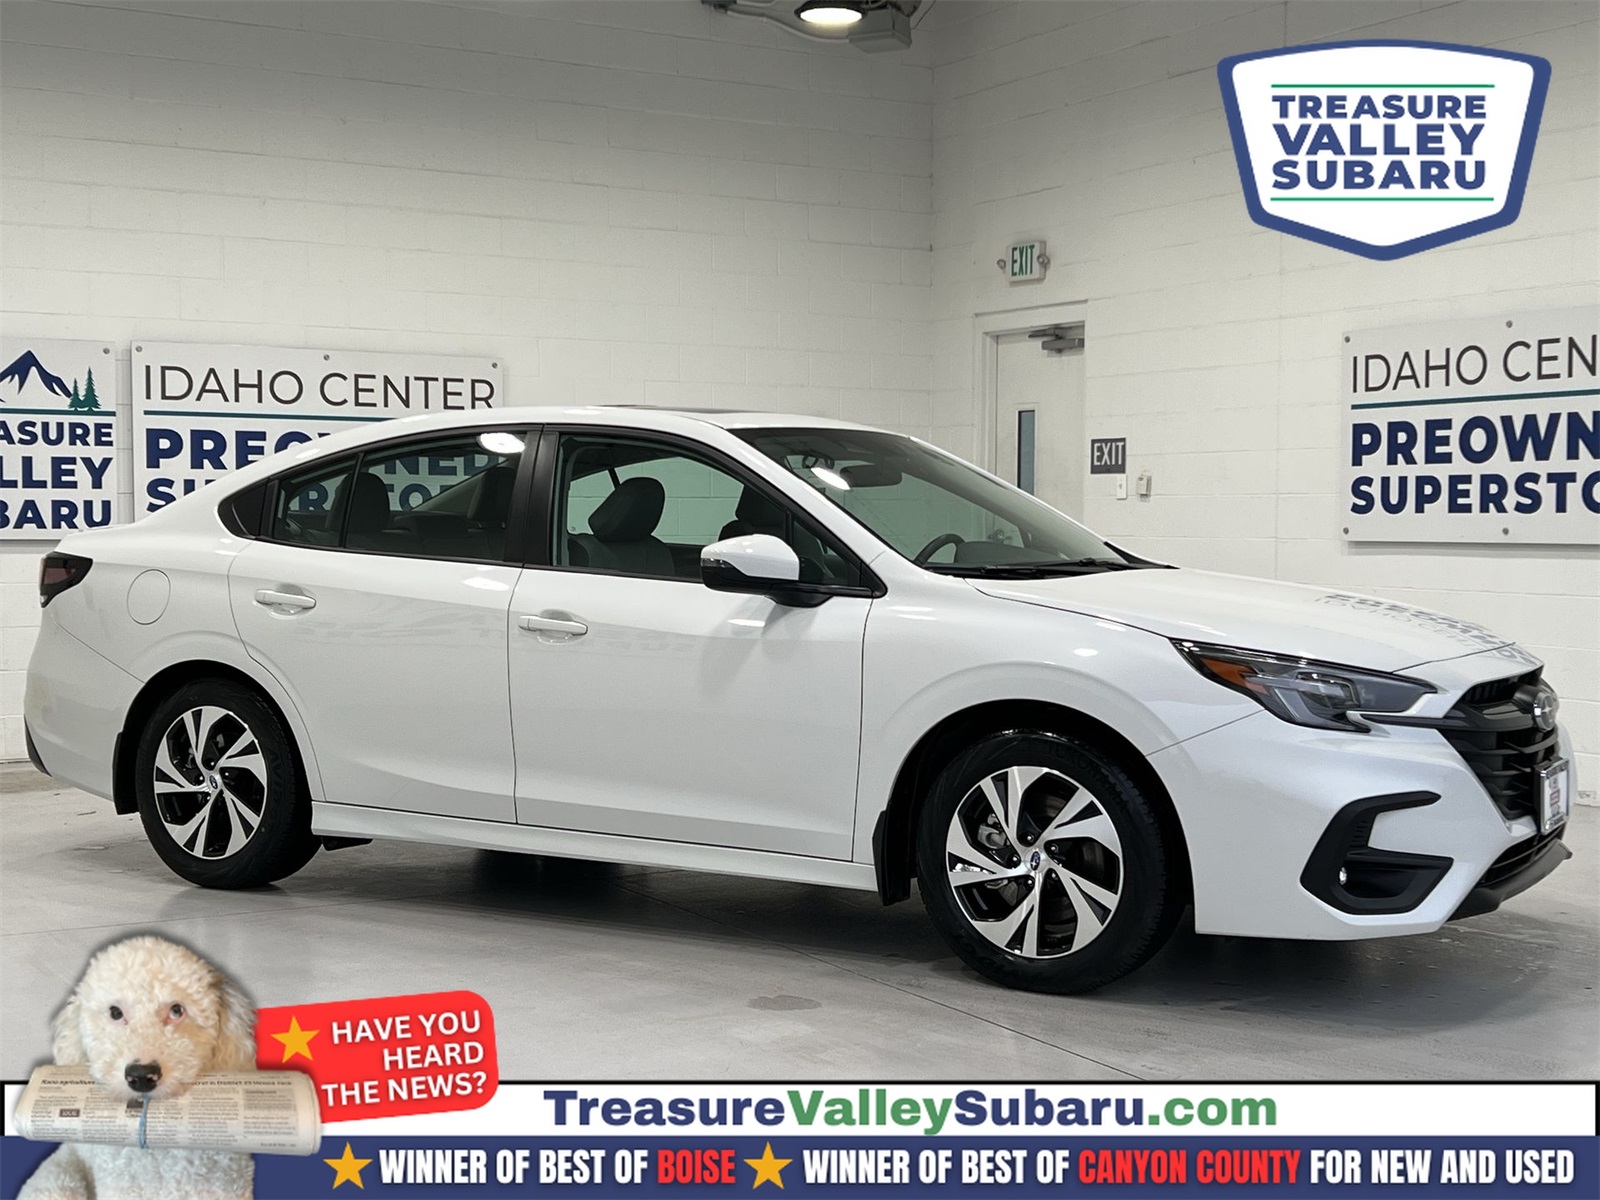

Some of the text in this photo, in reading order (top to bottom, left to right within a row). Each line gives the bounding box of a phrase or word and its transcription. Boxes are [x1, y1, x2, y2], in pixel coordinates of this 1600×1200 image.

[1010, 243, 1035, 277] EXIT
[144, 364, 495, 410] IDAHO CENTER
[1352, 334, 1598, 394] IDAHO CEN
[1093, 442, 1125, 466] EXIT
[1351, 410, 1600, 467] PREOWN
